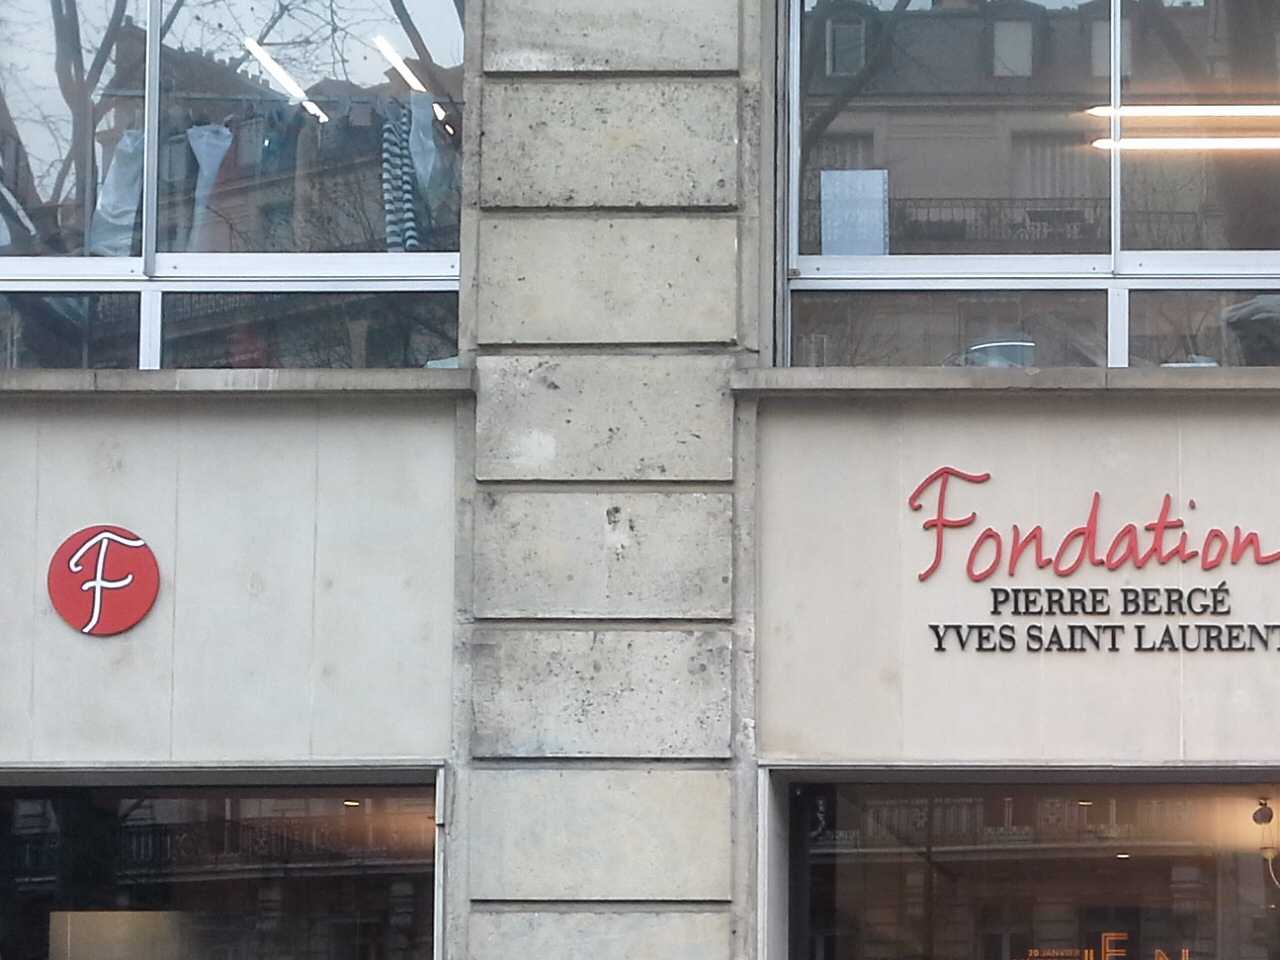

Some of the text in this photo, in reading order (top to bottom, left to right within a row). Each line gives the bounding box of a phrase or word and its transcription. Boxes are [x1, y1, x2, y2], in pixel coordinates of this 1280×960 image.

[990, 581, 1232, 616] PIERRE BERGÉ
[928, 624, 1016, 652] YVES
[1026, 624, 1126, 652] SAINT
